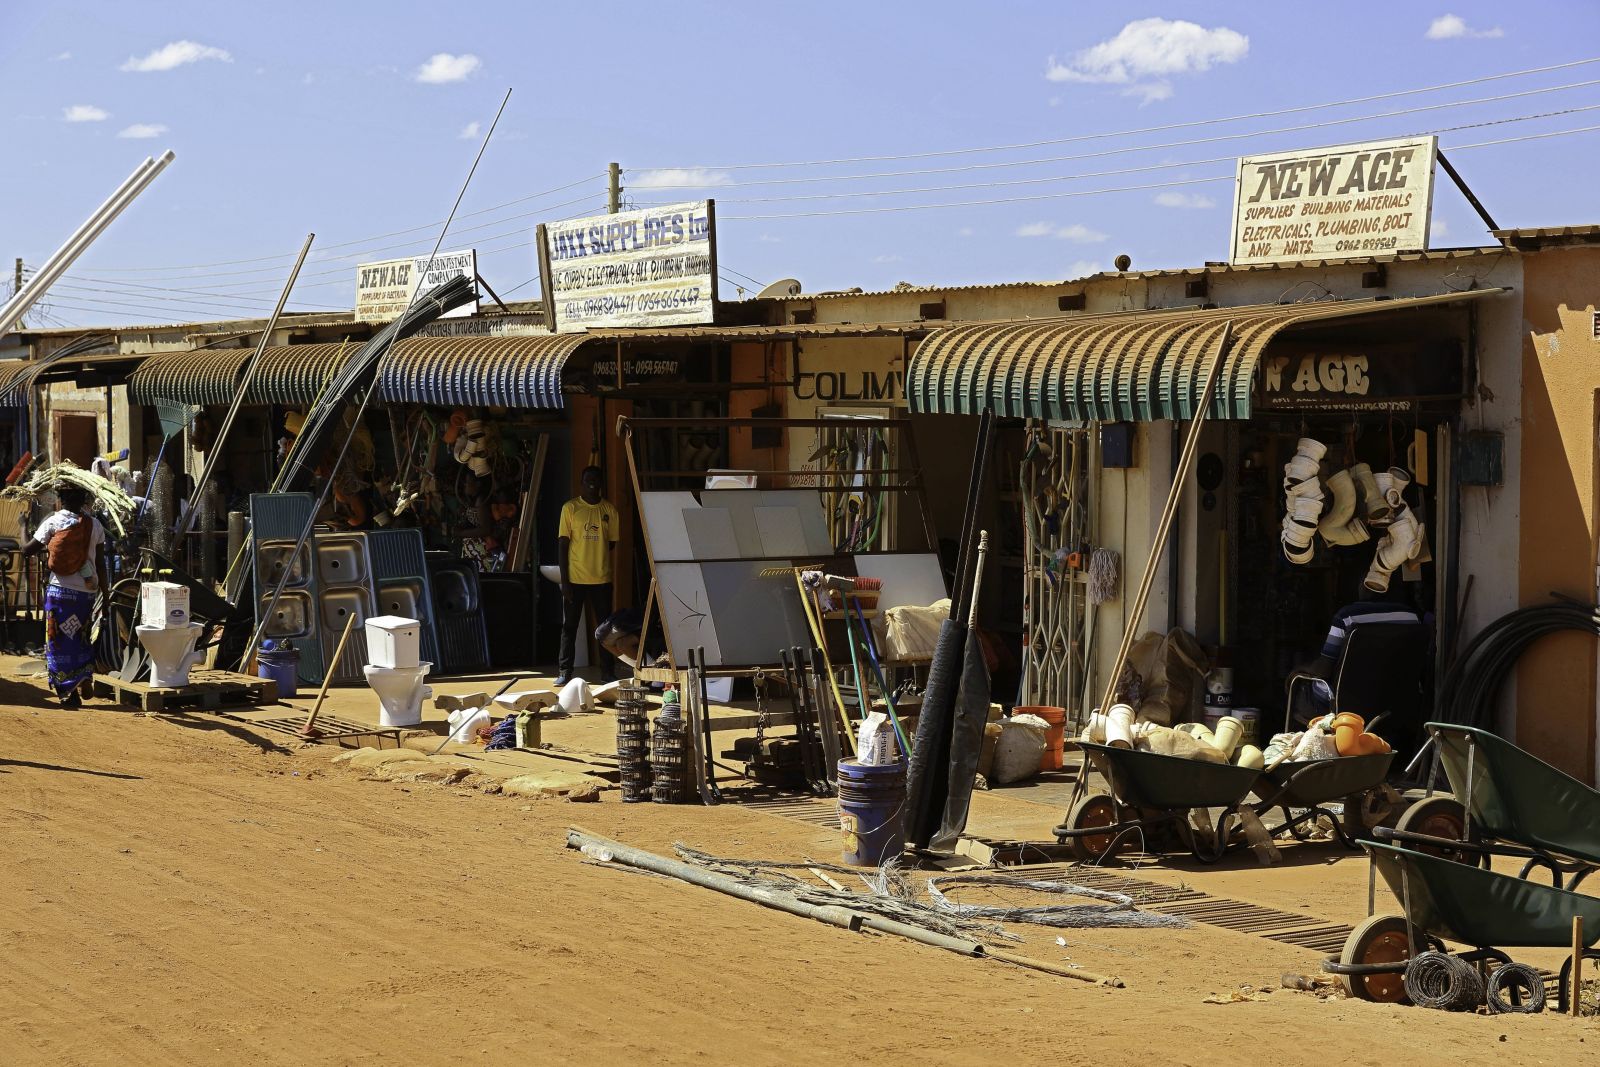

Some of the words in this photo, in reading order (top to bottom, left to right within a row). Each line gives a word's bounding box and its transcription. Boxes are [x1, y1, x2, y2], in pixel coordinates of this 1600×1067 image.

[1248, 157, 1341, 203] NEW
[1337, 149, 1414, 195] AGE
[1245, 204, 1295, 221] SUPPLIERS
[1301, 199, 1351, 217] BUILDING
[1353, 193, 1412, 213] MATERIALS
[588, 213, 684, 255] SUPPLIRES
[1383, 212, 1413, 232] BOLT
[1248, 243, 1272, 257] AND
[360, 267, 388, 289] NEW
[387, 264, 412, 287] AGE
[1292, 353, 1370, 395] AGE
